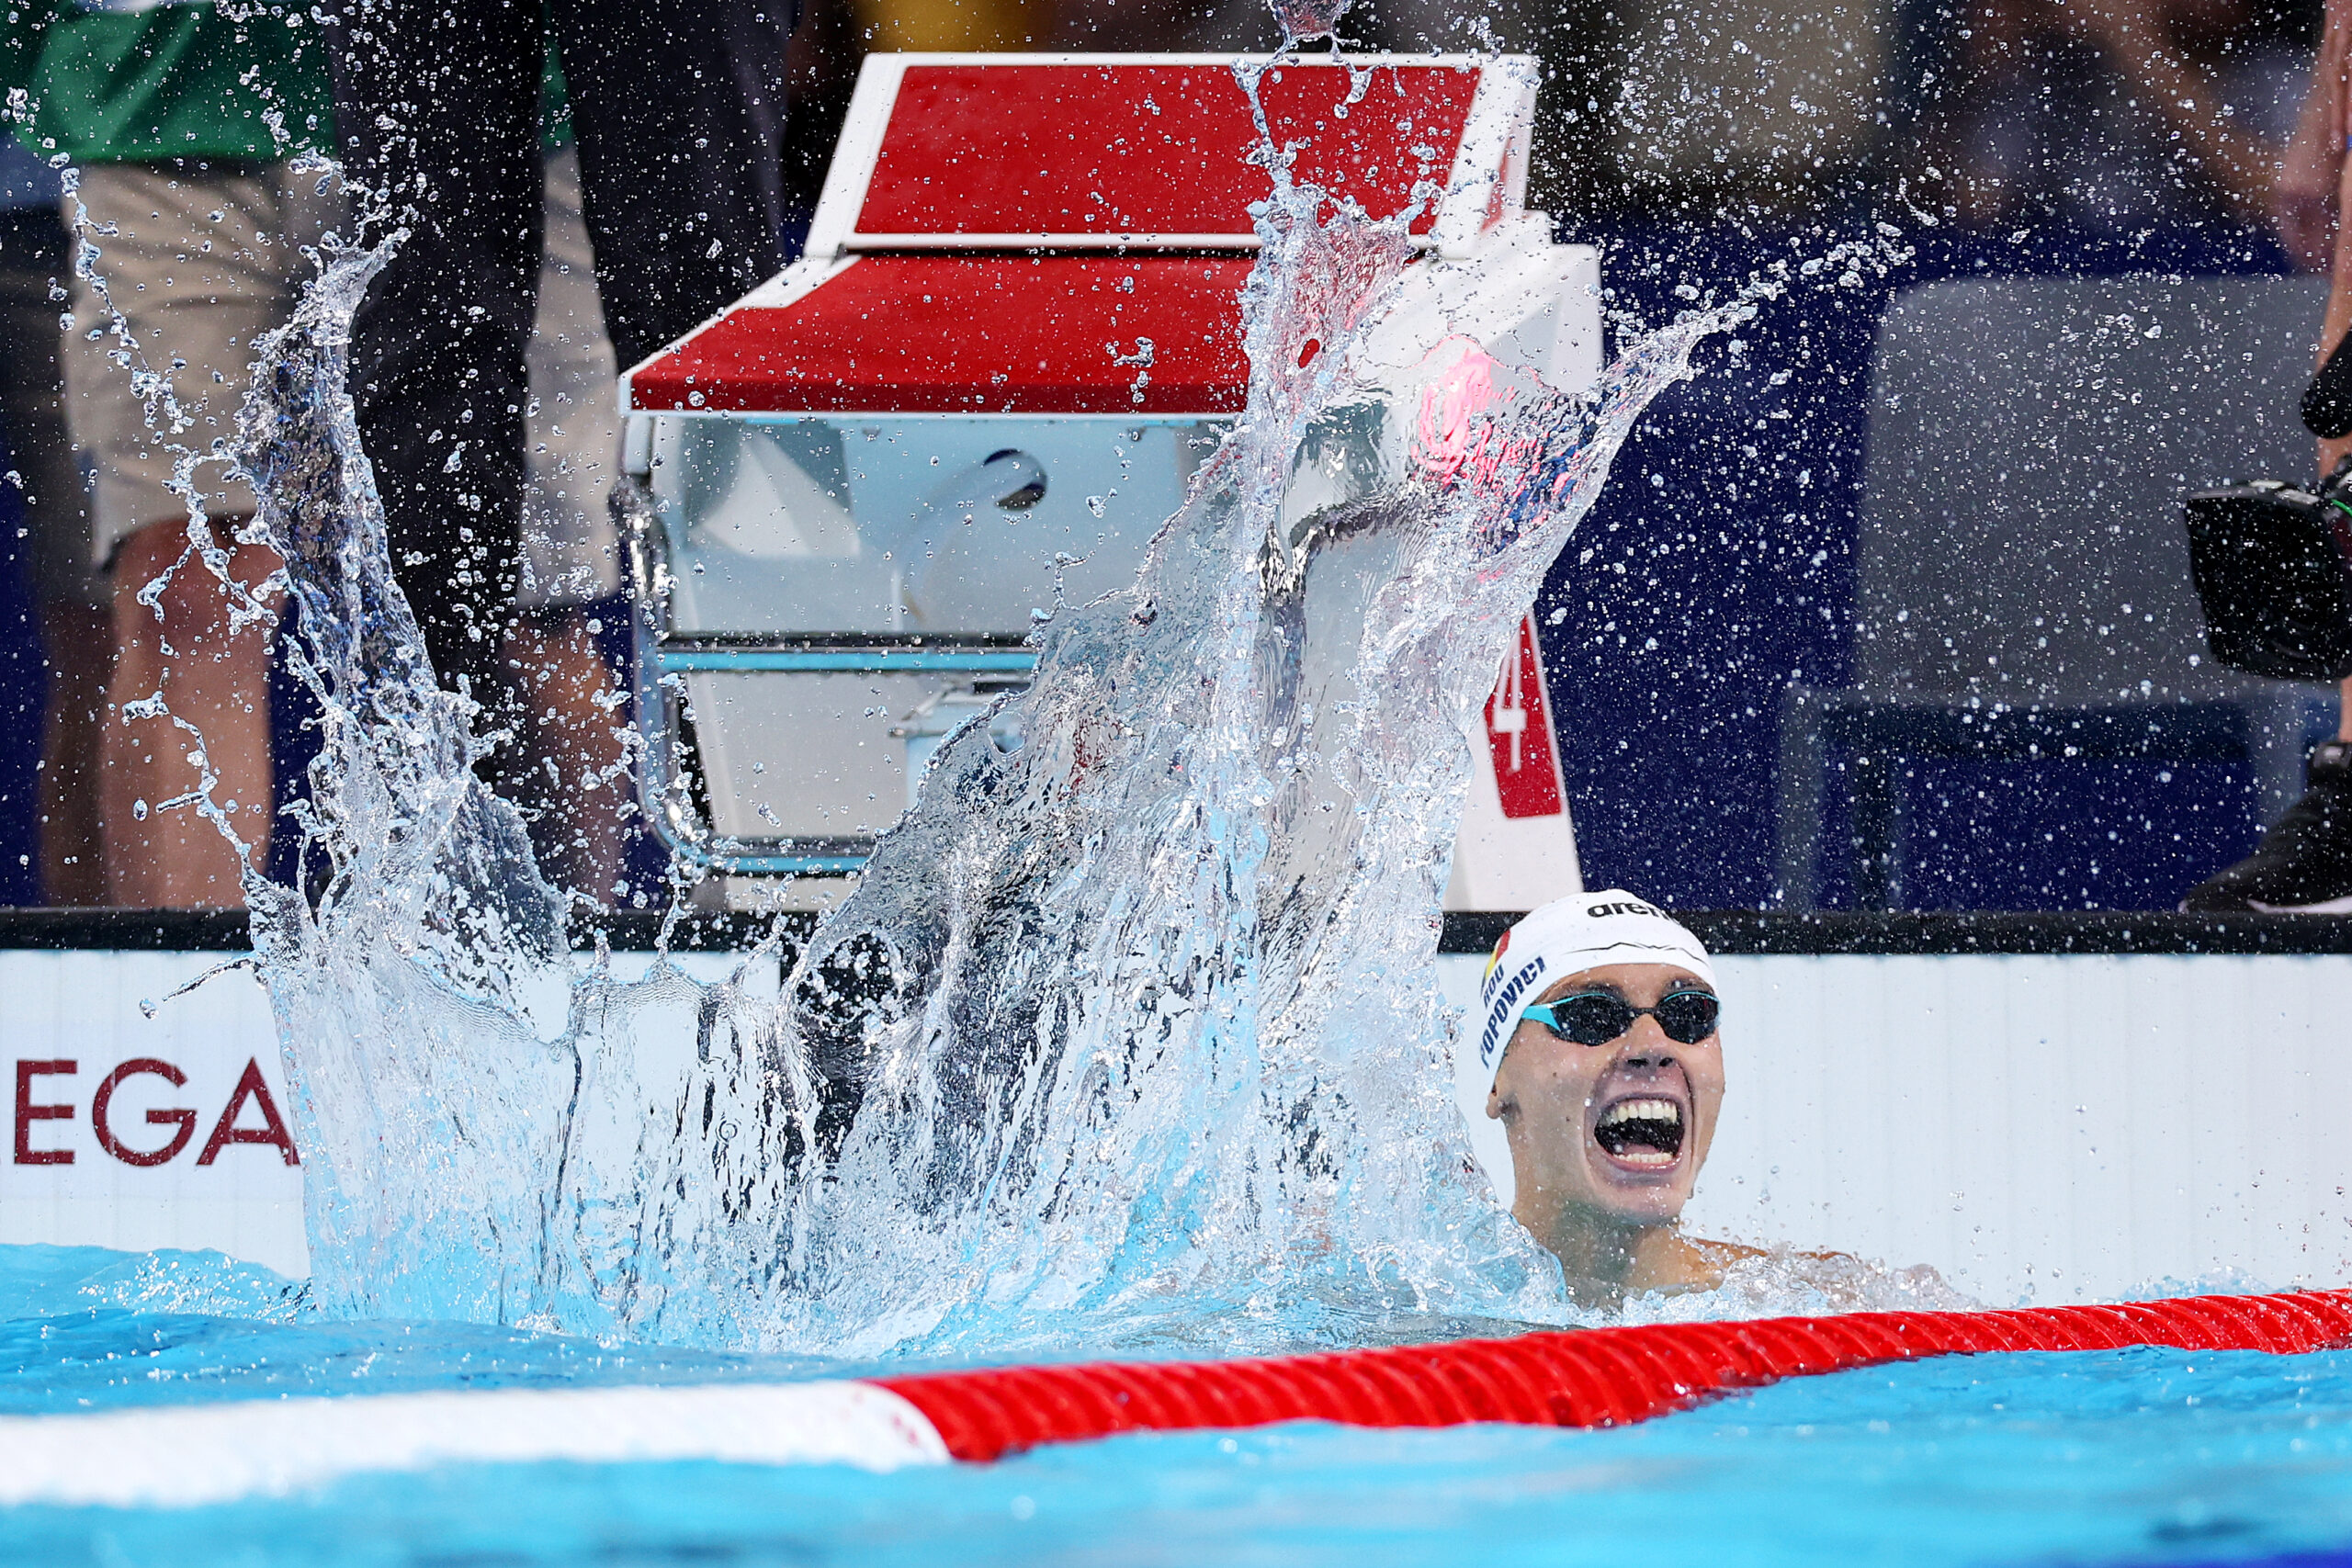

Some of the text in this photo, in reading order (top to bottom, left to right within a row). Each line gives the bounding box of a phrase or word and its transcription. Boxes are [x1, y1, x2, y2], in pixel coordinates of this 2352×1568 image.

[1493, 630, 1528, 772] 4
[1587, 902, 1680, 925] aren
[1480, 955, 1547, 1070] POPOVICI
[14, 1056, 301, 1167] EGA
